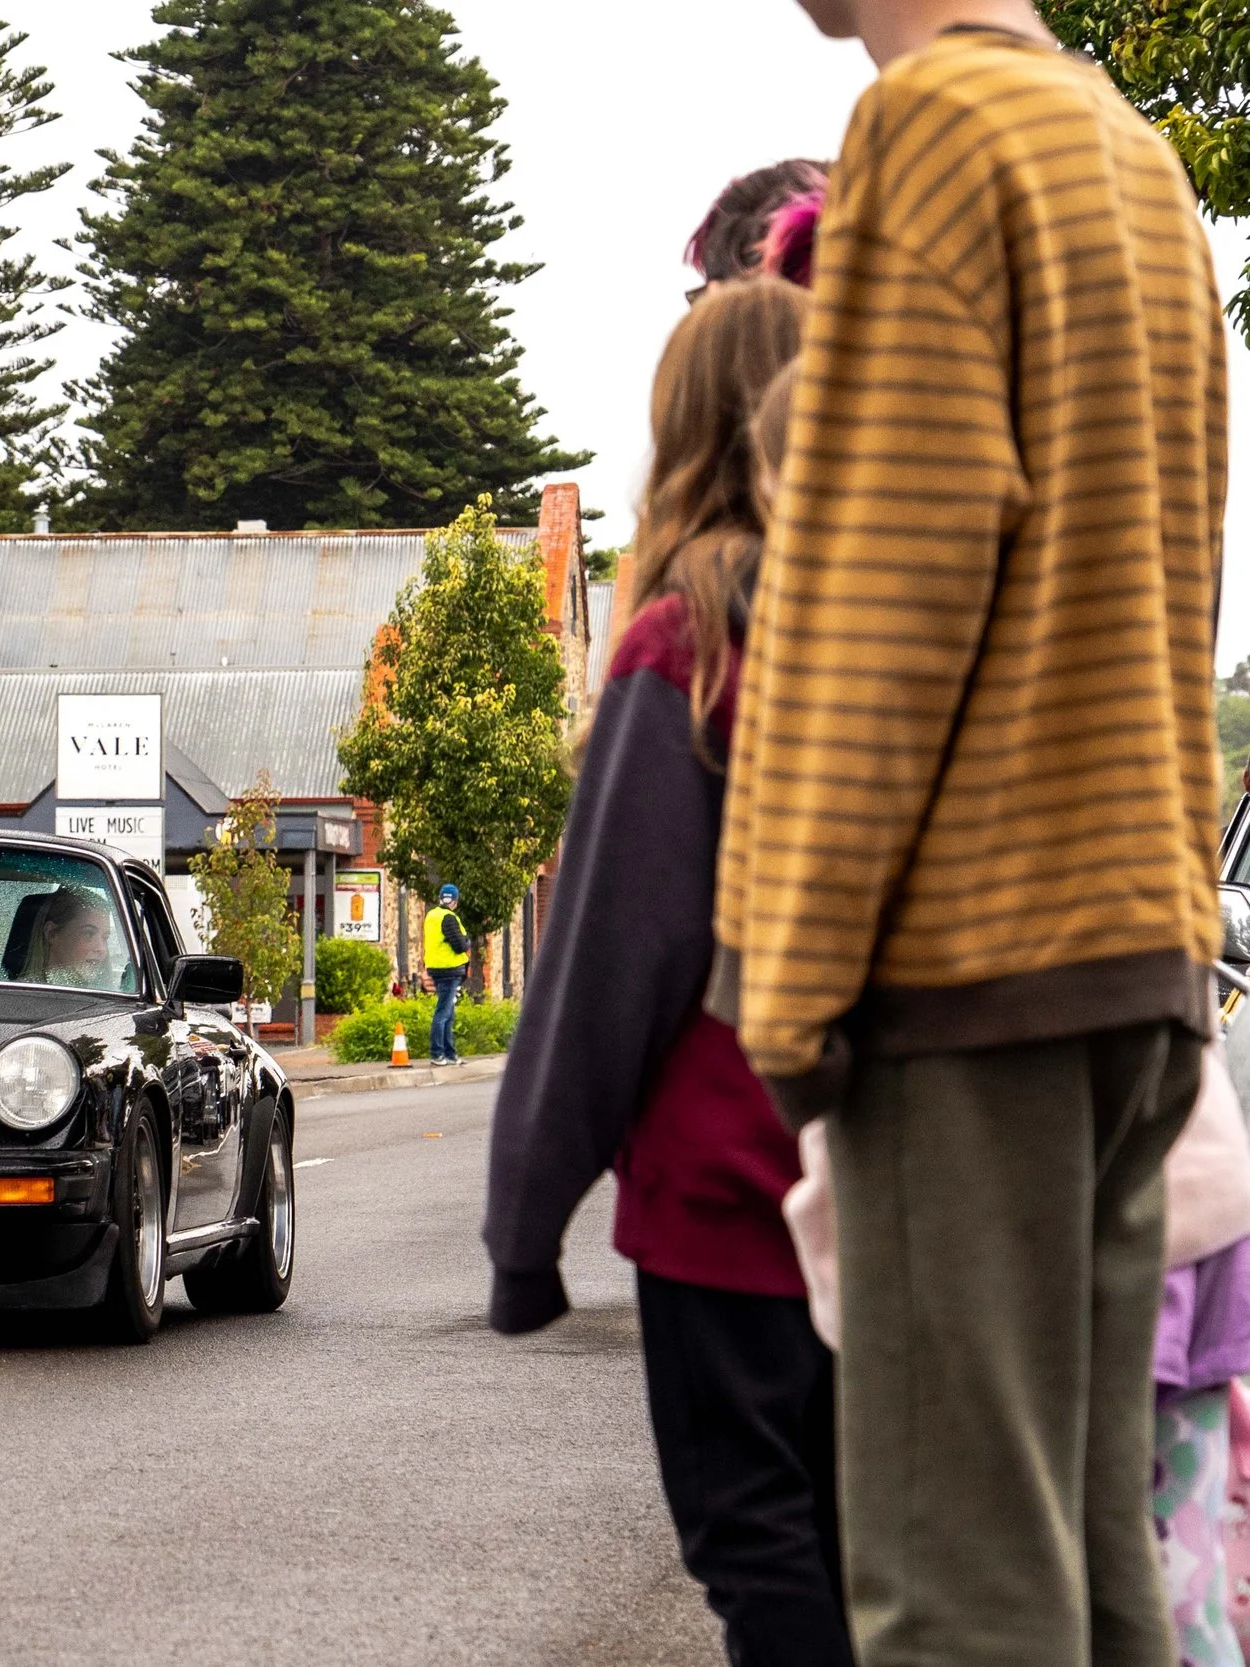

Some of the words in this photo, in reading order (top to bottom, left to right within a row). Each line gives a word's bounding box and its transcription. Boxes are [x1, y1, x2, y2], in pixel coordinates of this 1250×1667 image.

[71, 736, 149, 756] VALE
[69, 817, 95, 834] LIVE
[107, 817, 146, 834] MUSIC
